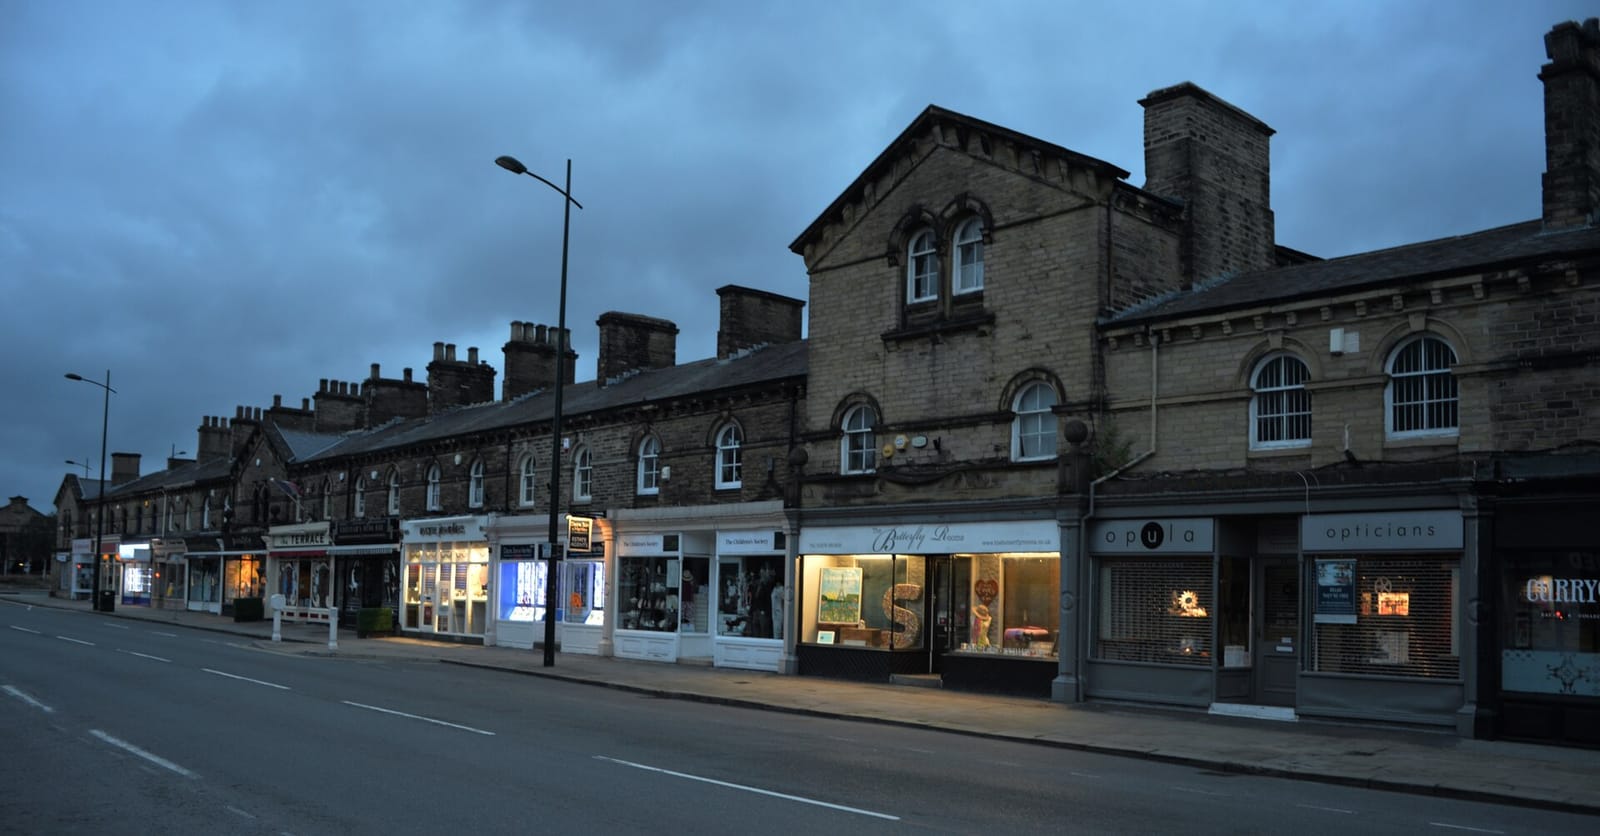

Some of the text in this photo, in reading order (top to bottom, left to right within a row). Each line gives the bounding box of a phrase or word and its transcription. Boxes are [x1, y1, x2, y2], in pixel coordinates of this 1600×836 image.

[291, 535, 324, 545] TERRACE
[872, 526, 964, 552] Butterfly Rooms
[1106, 522, 1194, 548] opula
[1326, 523, 1435, 541] opticians
[1526, 578, 1600, 603] CURRY
